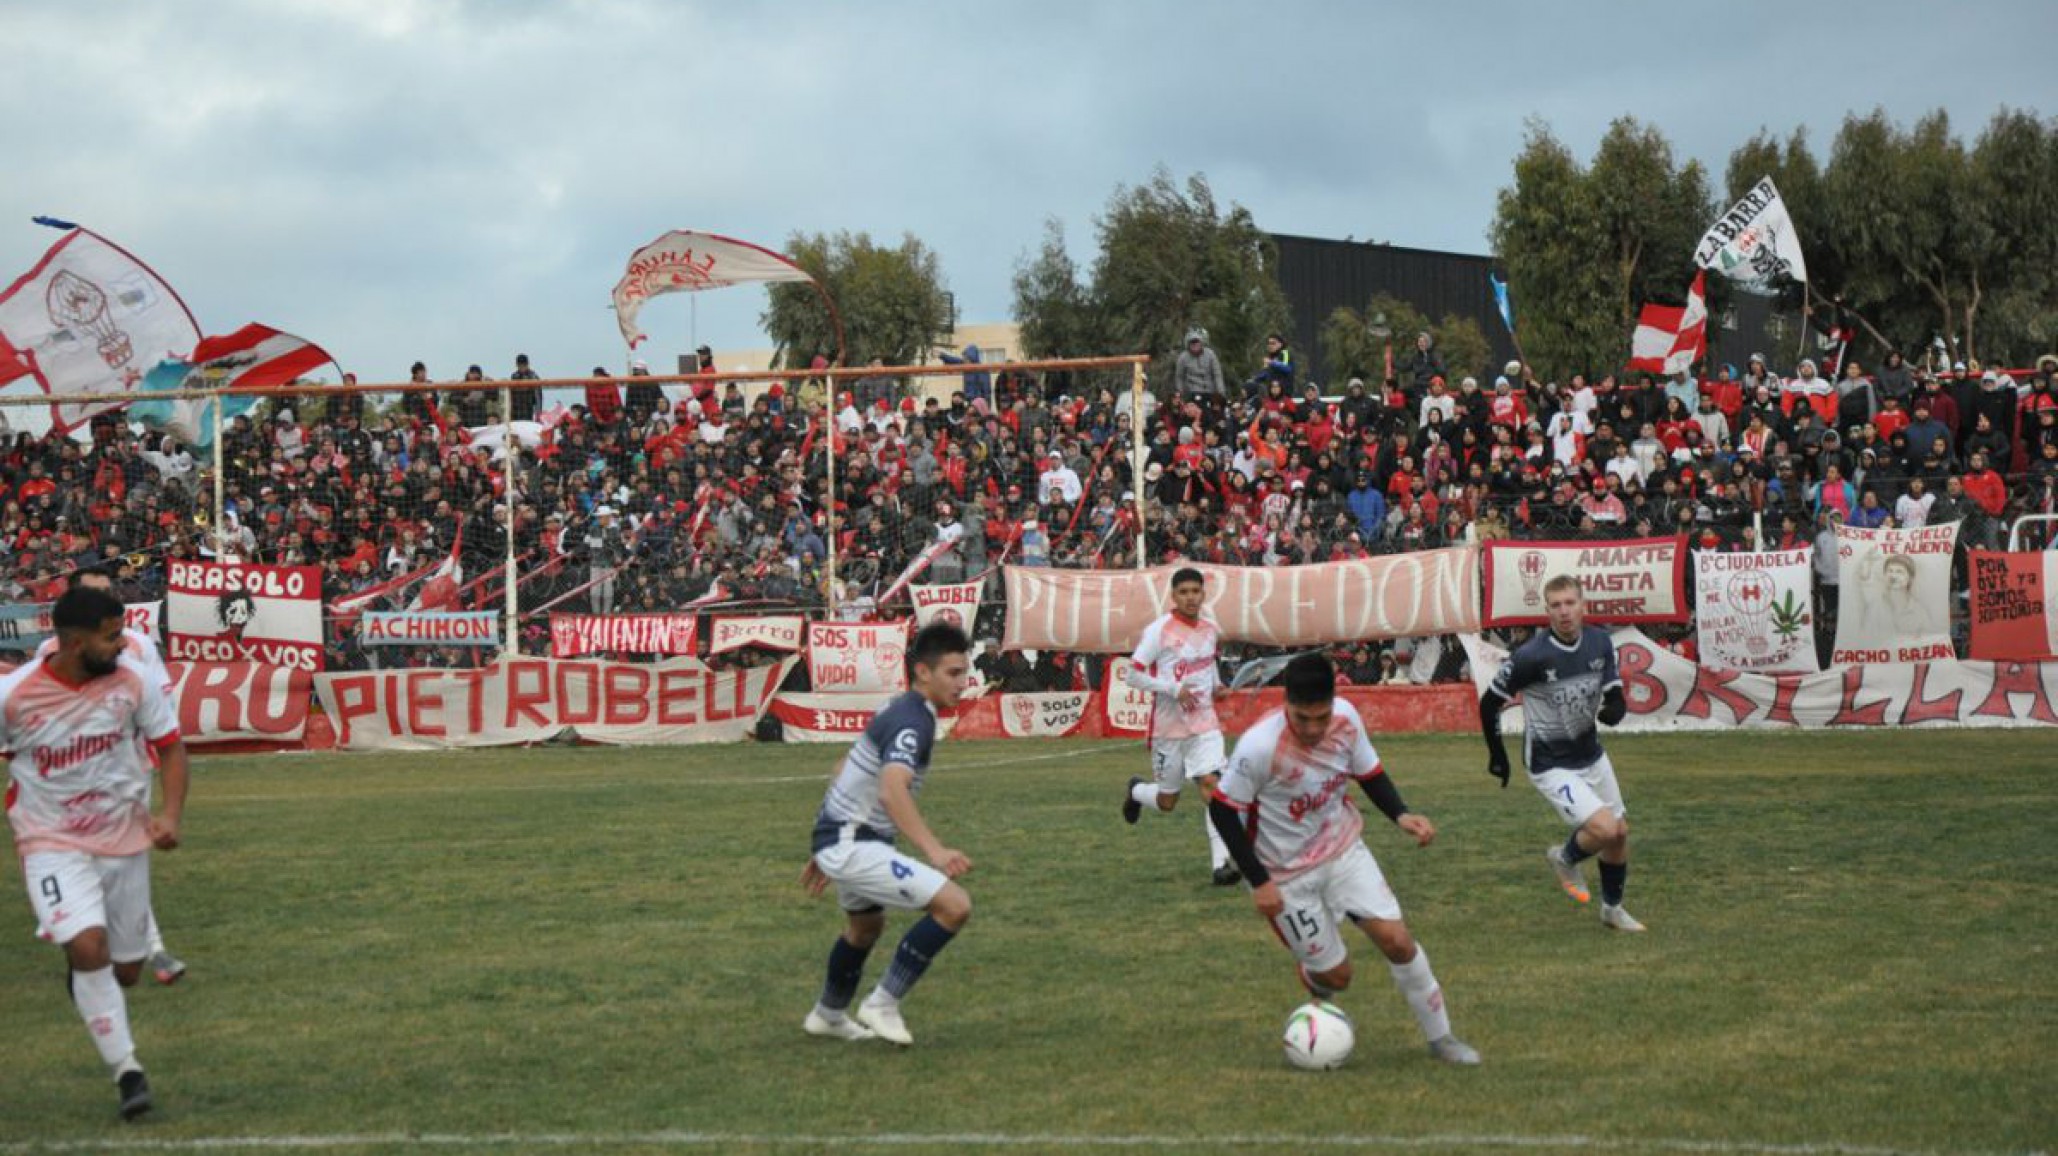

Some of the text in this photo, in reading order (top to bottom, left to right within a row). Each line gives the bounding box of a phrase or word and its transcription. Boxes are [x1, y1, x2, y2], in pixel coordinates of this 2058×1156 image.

[1578, 545, 1674, 568] AMARTE
[170, 563, 304, 596] ABASOLO
[916, 586, 977, 607] GLOBO
[813, 627, 877, 649] SOS MI
[170, 636, 234, 661] LOCO
[262, 644, 318, 672] VOS
[816, 662, 857, 687] VIDA
[1041, 696, 1081, 713] SOLO
[1558, 783, 1585, 804] 7
[890, 858, 914, 880] 4
[41, 875, 62, 906] 9
[1285, 910, 1320, 942] 15
